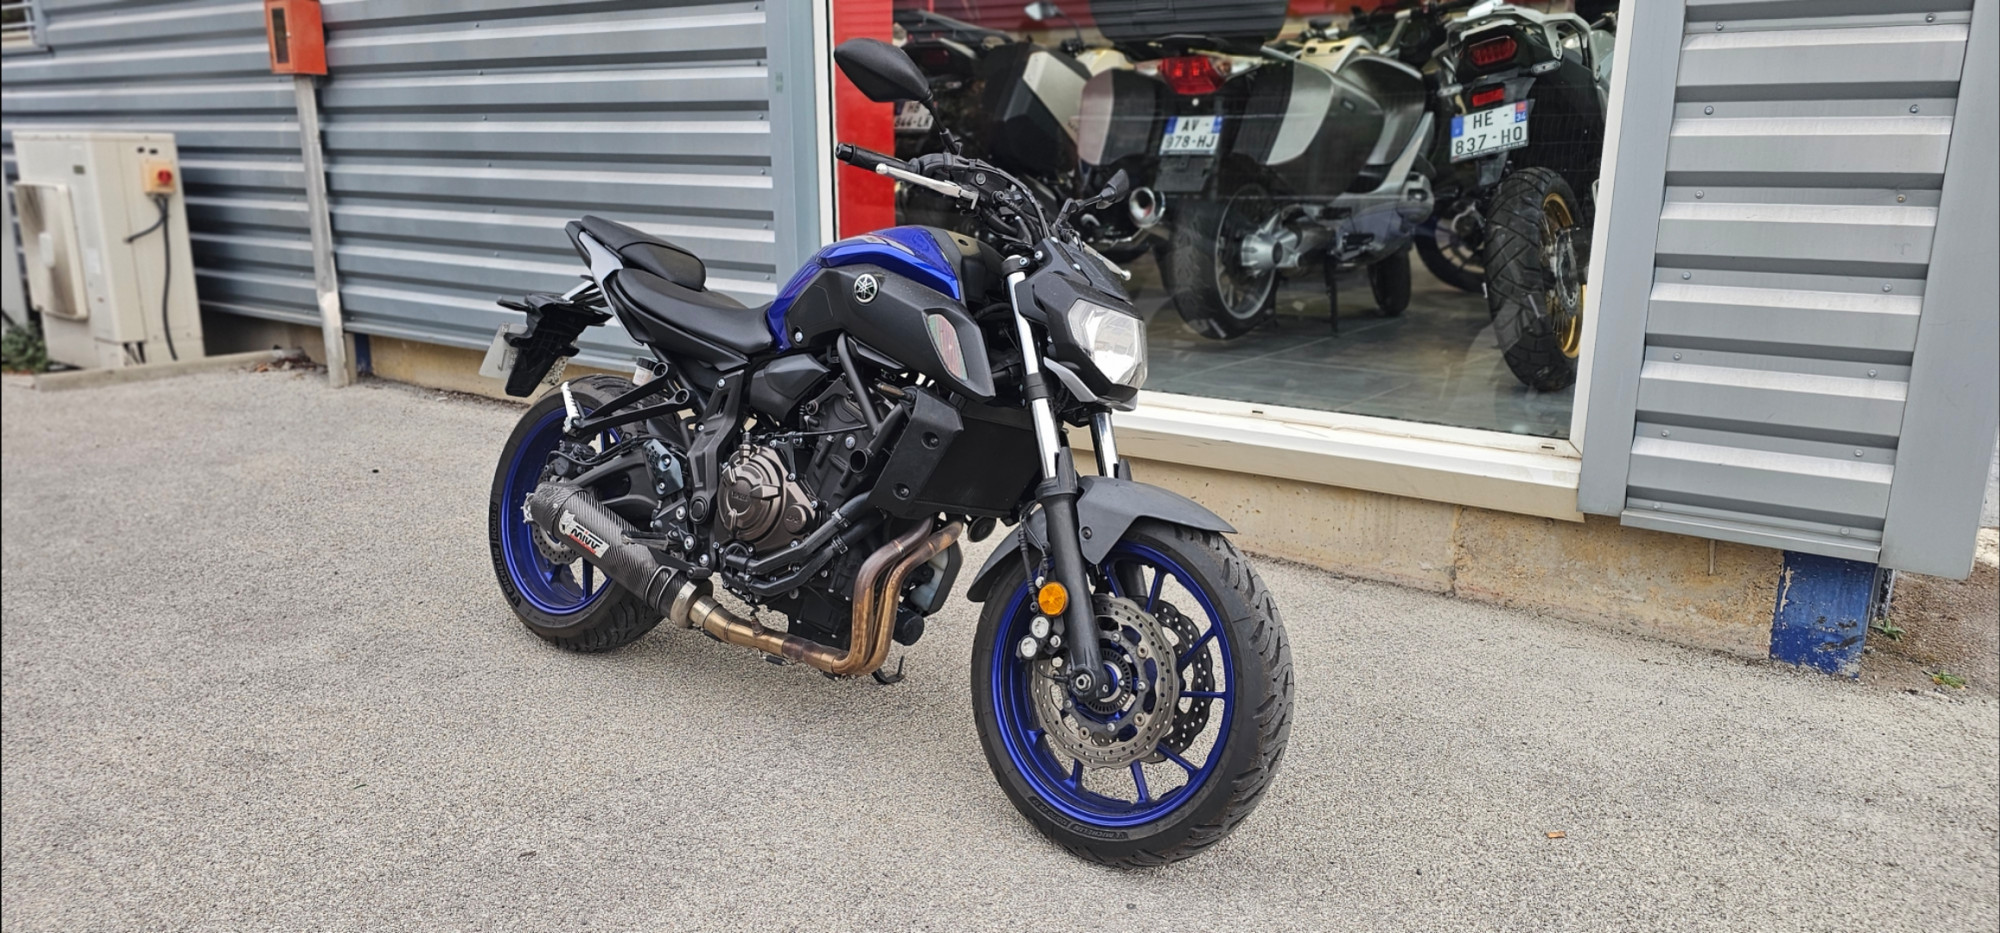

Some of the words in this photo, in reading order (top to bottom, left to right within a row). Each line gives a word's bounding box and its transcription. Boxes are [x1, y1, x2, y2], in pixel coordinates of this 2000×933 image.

[1181, 119, 1200, 131] AV
[1473, 111, 1494, 129] HE
[493, 547, 512, 593] MICHELIN
[1072, 825, 1114, 838] MICHELIN
